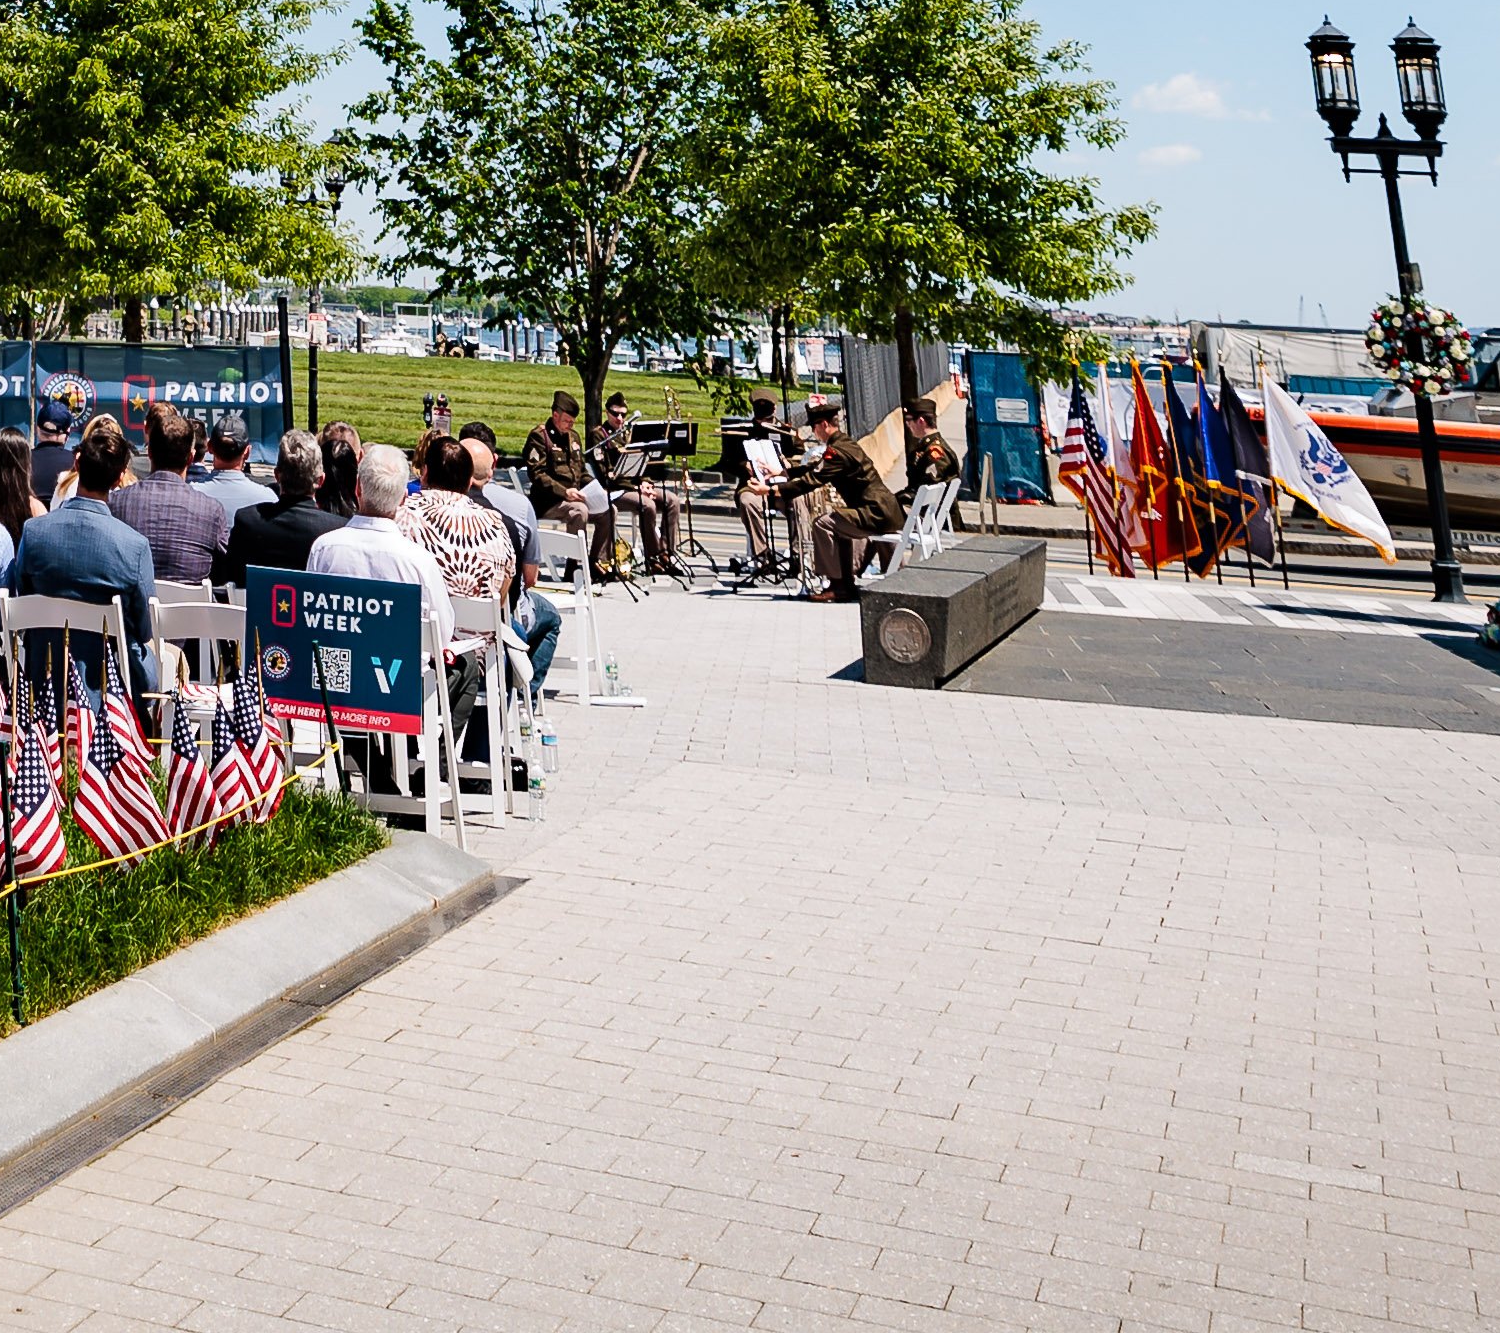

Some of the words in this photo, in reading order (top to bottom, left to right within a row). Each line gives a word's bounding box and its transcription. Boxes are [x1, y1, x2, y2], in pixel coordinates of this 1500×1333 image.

[164, 381, 283, 403] PATRIOT
[1451, 532, 1493, 542] TRIOT
[303, 591, 394, 616] PATRIOT
[304, 611, 362, 633] WEEK
[272, 703, 296, 715] SCAN
[297, 706, 321, 718] HERE
[322, 709, 342, 720] FR
[341, 711, 368, 723] MORE
[369, 715, 391, 727] INFO
